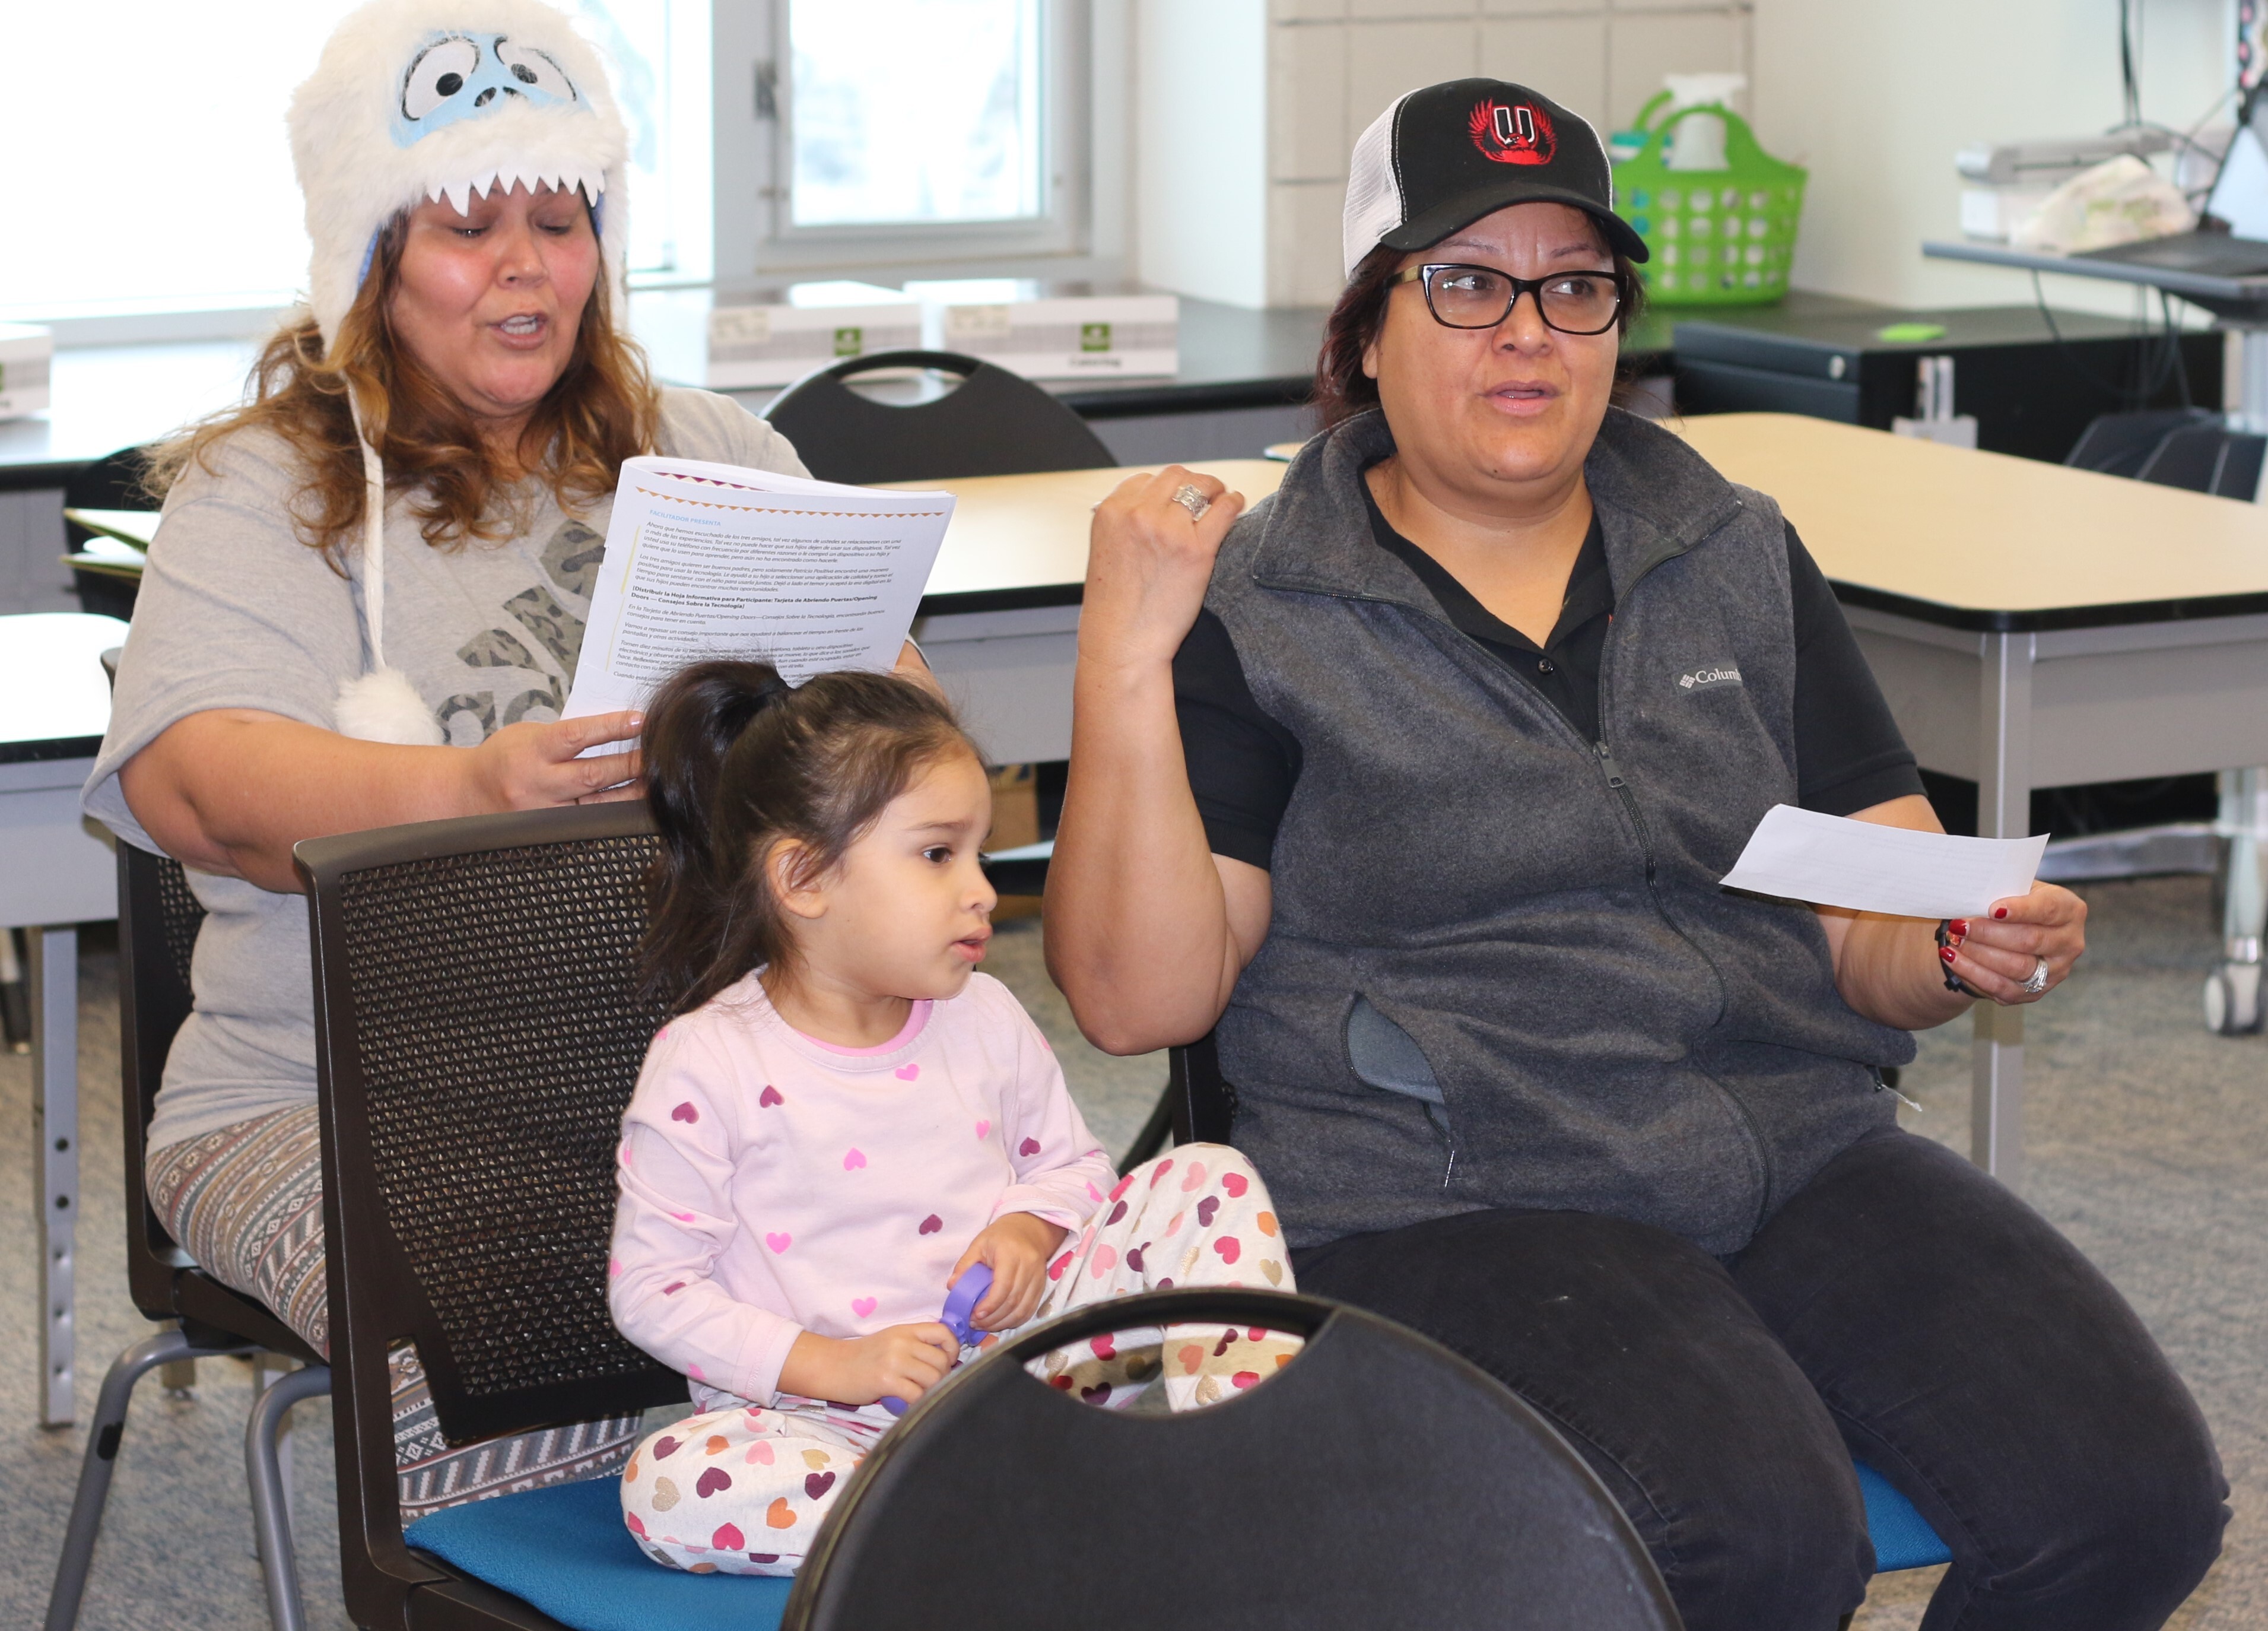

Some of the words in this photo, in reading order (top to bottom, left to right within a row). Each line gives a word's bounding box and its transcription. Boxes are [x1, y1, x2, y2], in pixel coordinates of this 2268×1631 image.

[650, 510, 689, 522] FACILITADOR
[647, 522, 663, 530] Ahora
[679, 536, 713, 544] experiencias.
[637, 567, 656, 576] tiempo
[633, 586, 663, 595] [Distribuir
[658, 597, 685, 605] Consejos
[1695, 668, 1742, 684] Columb
